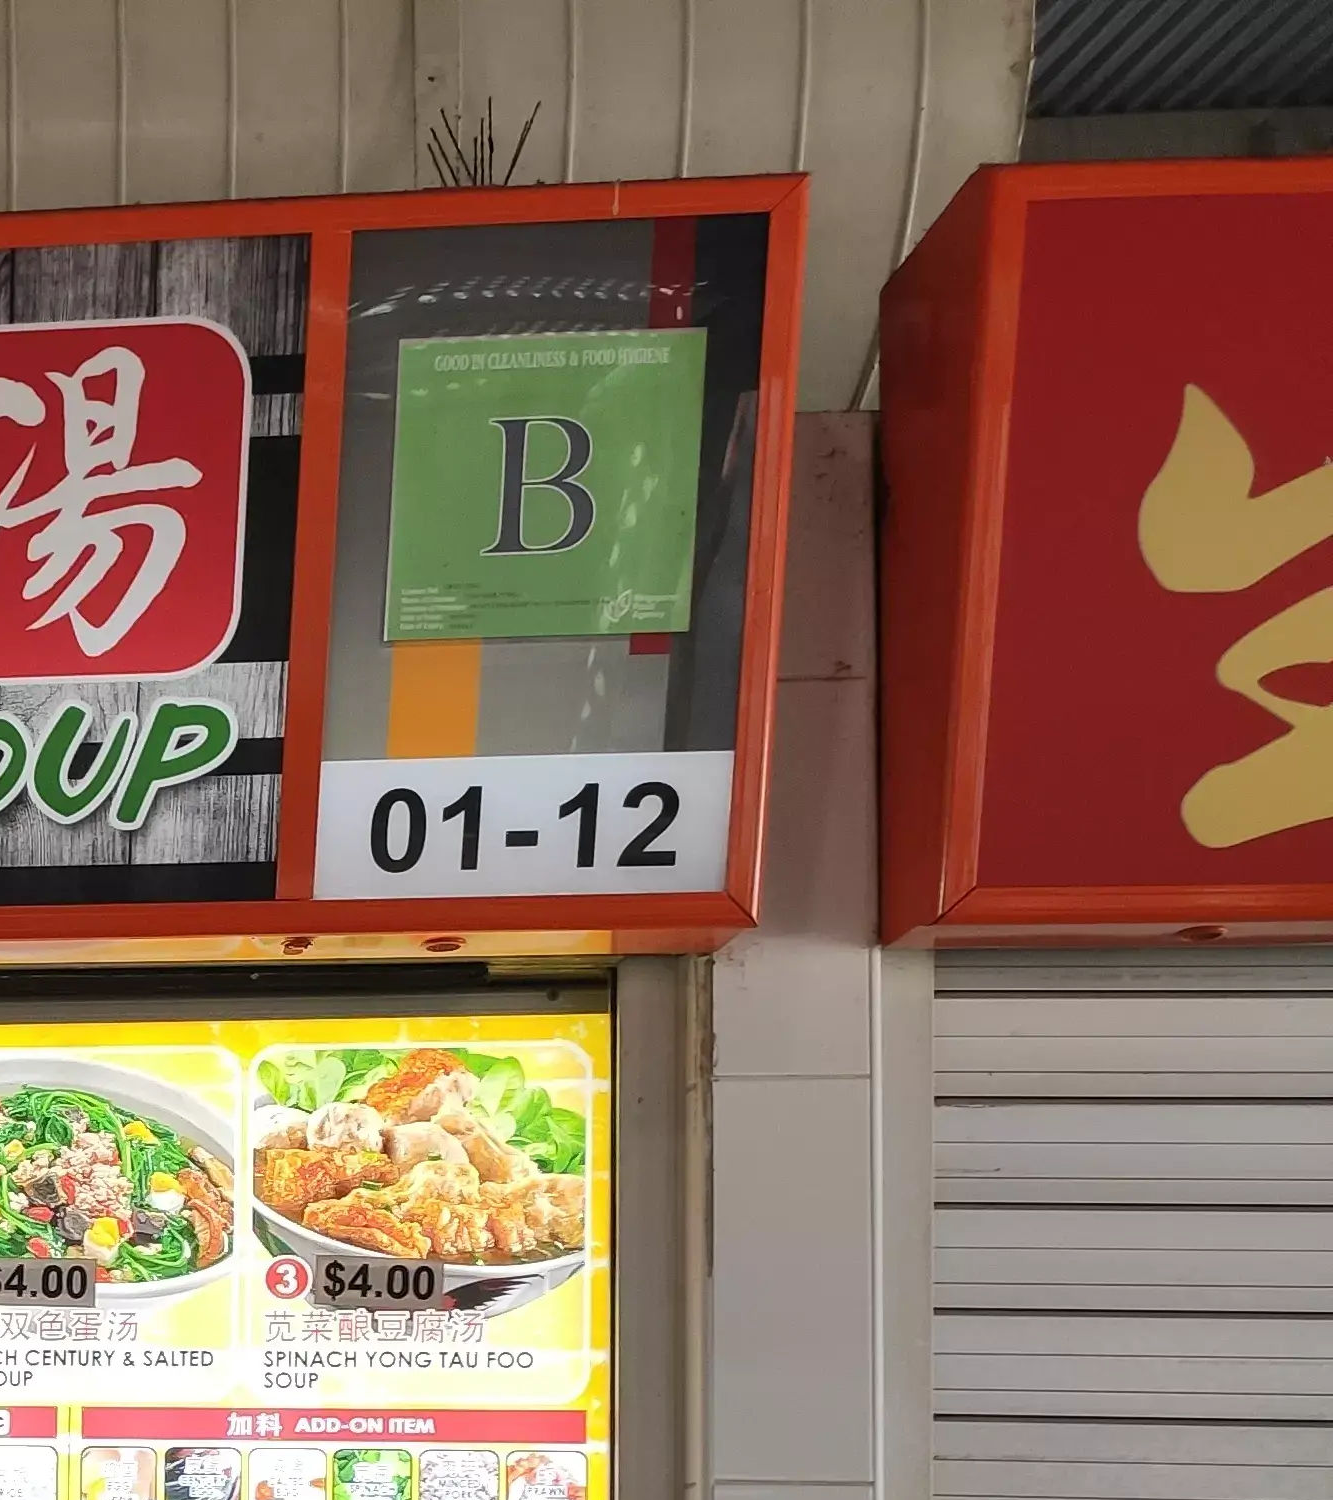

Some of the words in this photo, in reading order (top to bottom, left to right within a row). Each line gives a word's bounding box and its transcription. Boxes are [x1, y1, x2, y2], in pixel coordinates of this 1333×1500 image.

[434, 353, 469, 371] GOOD
[487, 351, 567, 370] CLEANLINESS
[582, 350, 616, 366] FOOD
[480, 414, 597, 557] B
[369, 781, 682, 874] 01-12
[322, 1259, 436, 1301] $4.00
[24, 1349, 116, 1368] CENTURY
[122, 1350, 136, 1368] &
[143, 1350, 215, 1368] SALTED
[263, 1351, 357, 1369] SPINACH
[365, 1351, 433, 1369] YONG
[440, 1351, 478, 1369] TAU
[487, 1351, 534, 1369] FOO
[263, 1371, 319, 1389] SOUP
[226, 1411, 283, 1437] 加料
[294, 1416, 383, 1434] ADD-ON
[387, 1417, 436, 1435] ITEM
